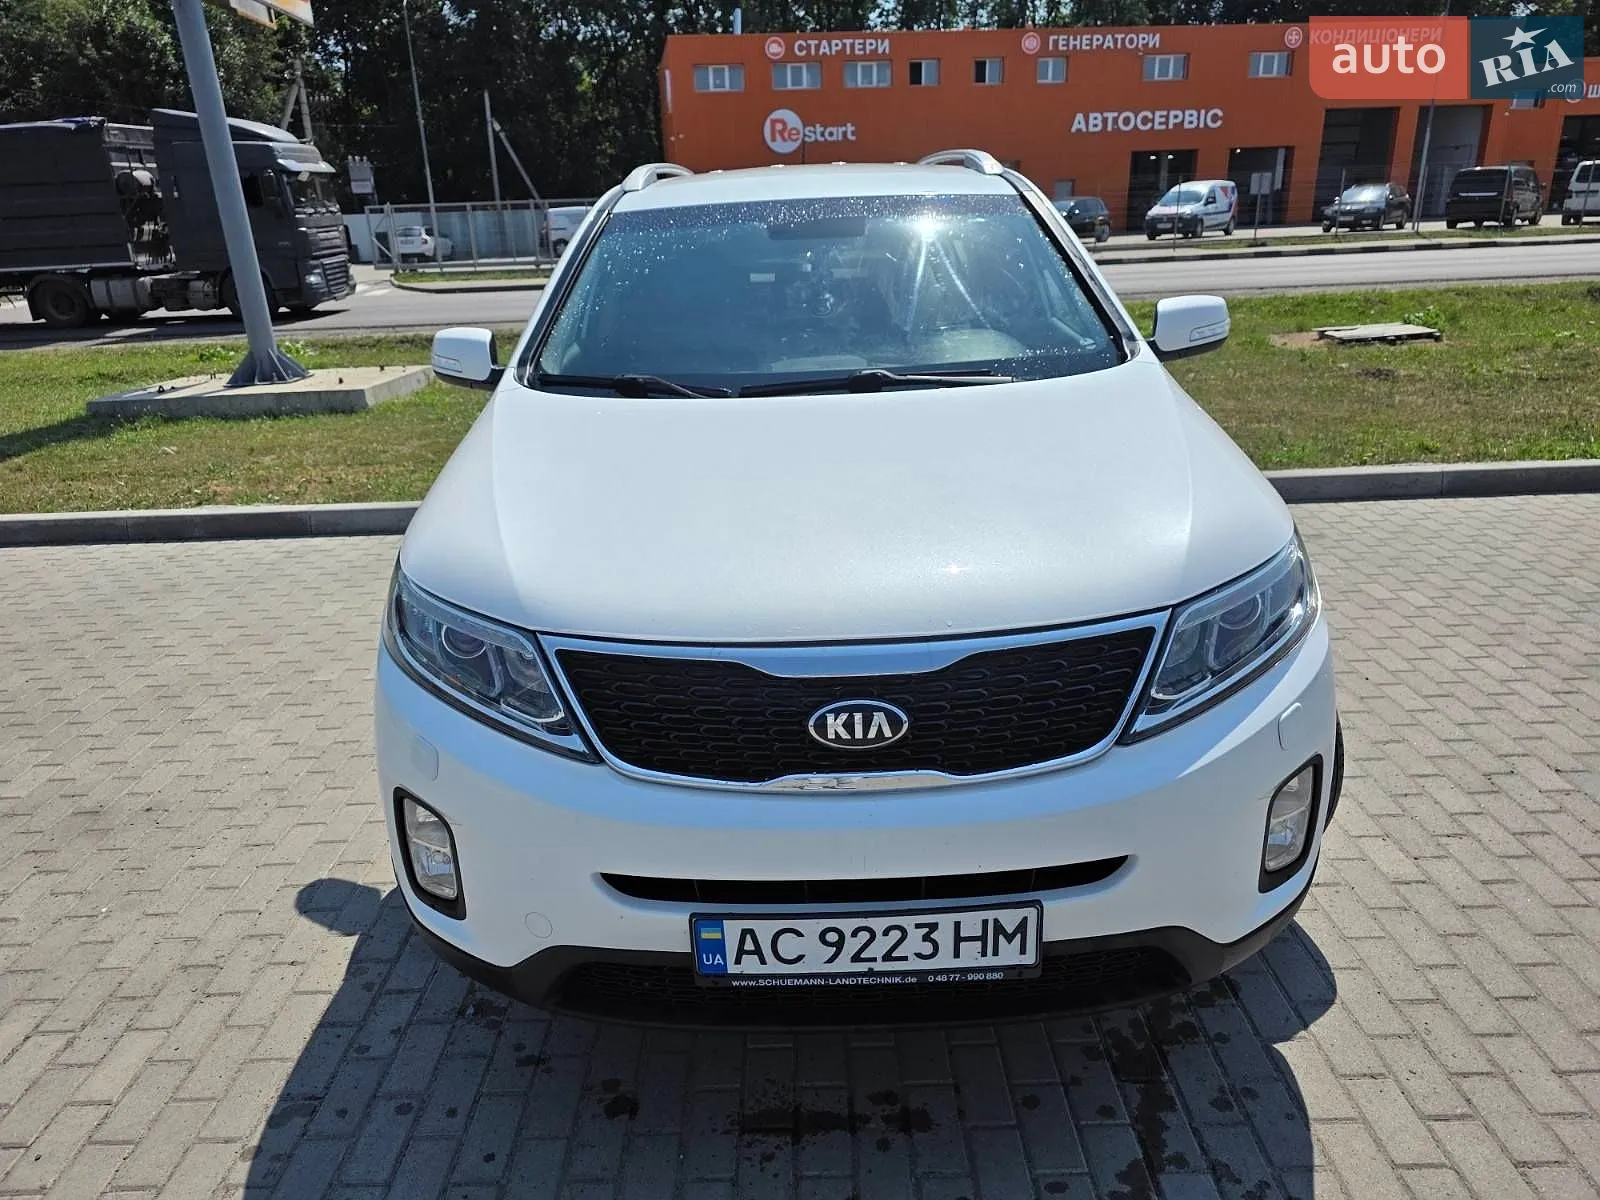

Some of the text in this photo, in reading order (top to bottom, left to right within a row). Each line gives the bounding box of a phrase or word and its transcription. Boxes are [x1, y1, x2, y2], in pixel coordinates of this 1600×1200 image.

[794, 38, 890, 56] СТАРТЕРИ
[1048, 32, 1160, 51] ГЕНЕРАТОРИ
[769, 117, 857, 143] Restart
[1070, 108, 1224, 133] АВТОСЕРВІС
[825, 711, 893, 739] KIA
[734, 915, 1028, 965] AC 9223 HM
[702, 952, 724, 966] UA
[731, 976, 917, 987] www.SCHUEMANN-LANDTECHNIK.de
